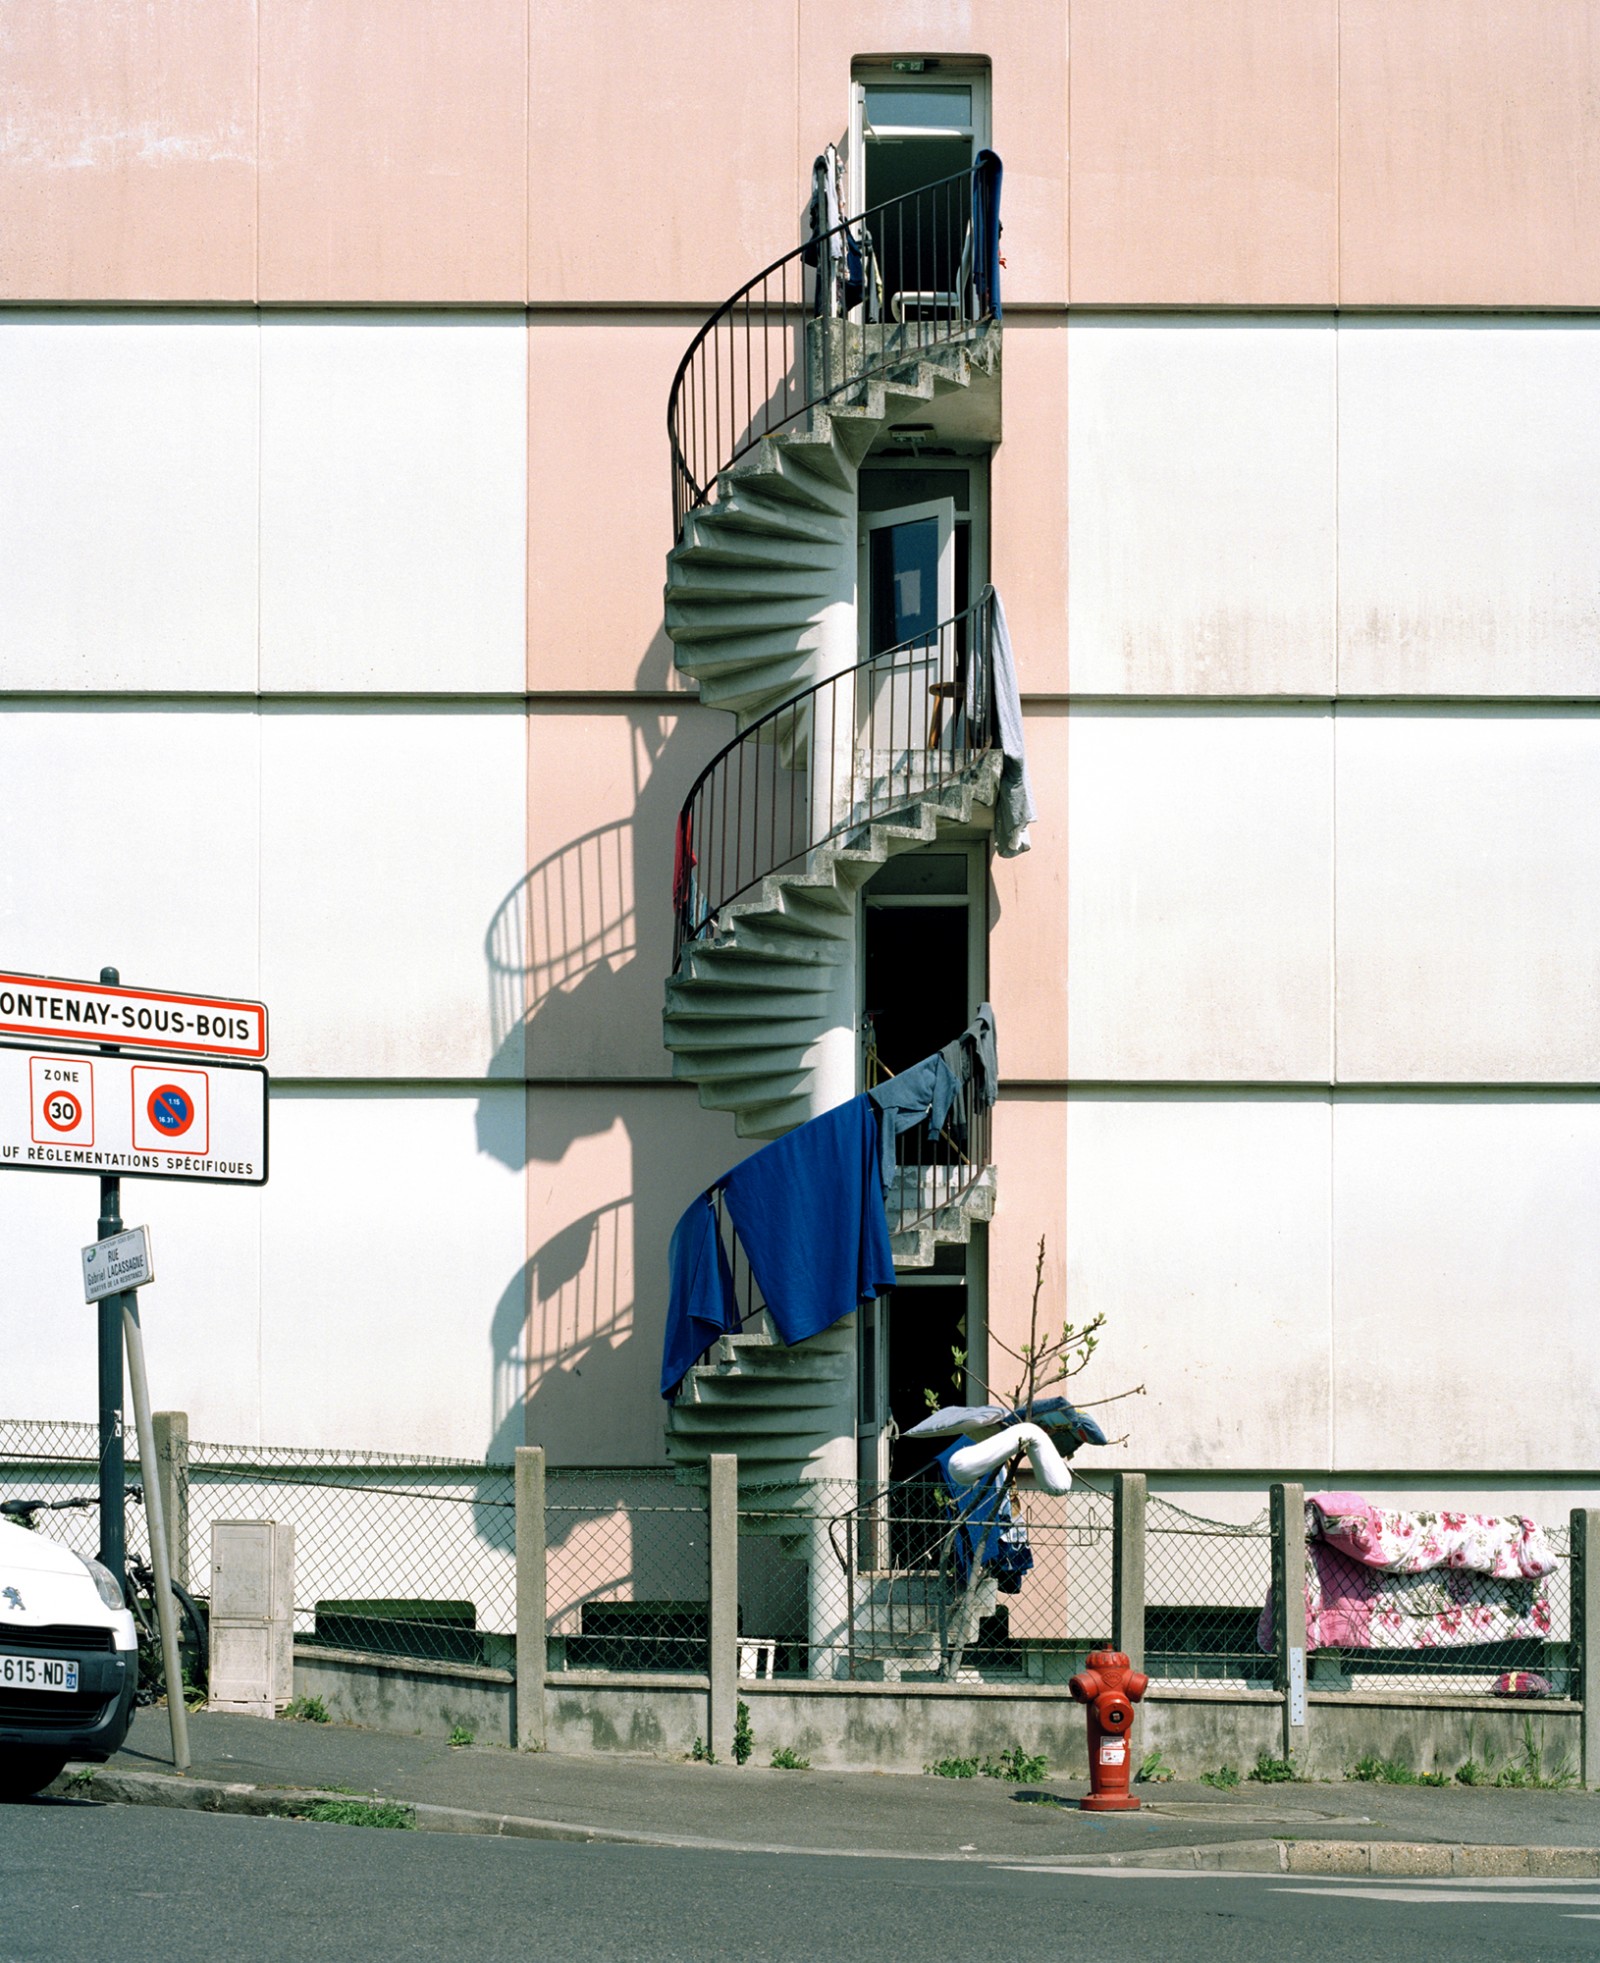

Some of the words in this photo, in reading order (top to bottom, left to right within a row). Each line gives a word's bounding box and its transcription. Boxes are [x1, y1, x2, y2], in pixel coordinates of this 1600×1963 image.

[0, 991, 250, 1040] ONTENAY-SOUS-BOIS
[44, 1069, 79, 1082] ZONE
[51, 1102, 75, 1120] 30
[0, 1145, 20, 1158] UF
[28, 1146, 159, 1168] RÉGLEMENTATIONS
[167, 1156, 253, 1175] SPÉCIFIQUES
[108, 1248, 119, 1262] RUE
